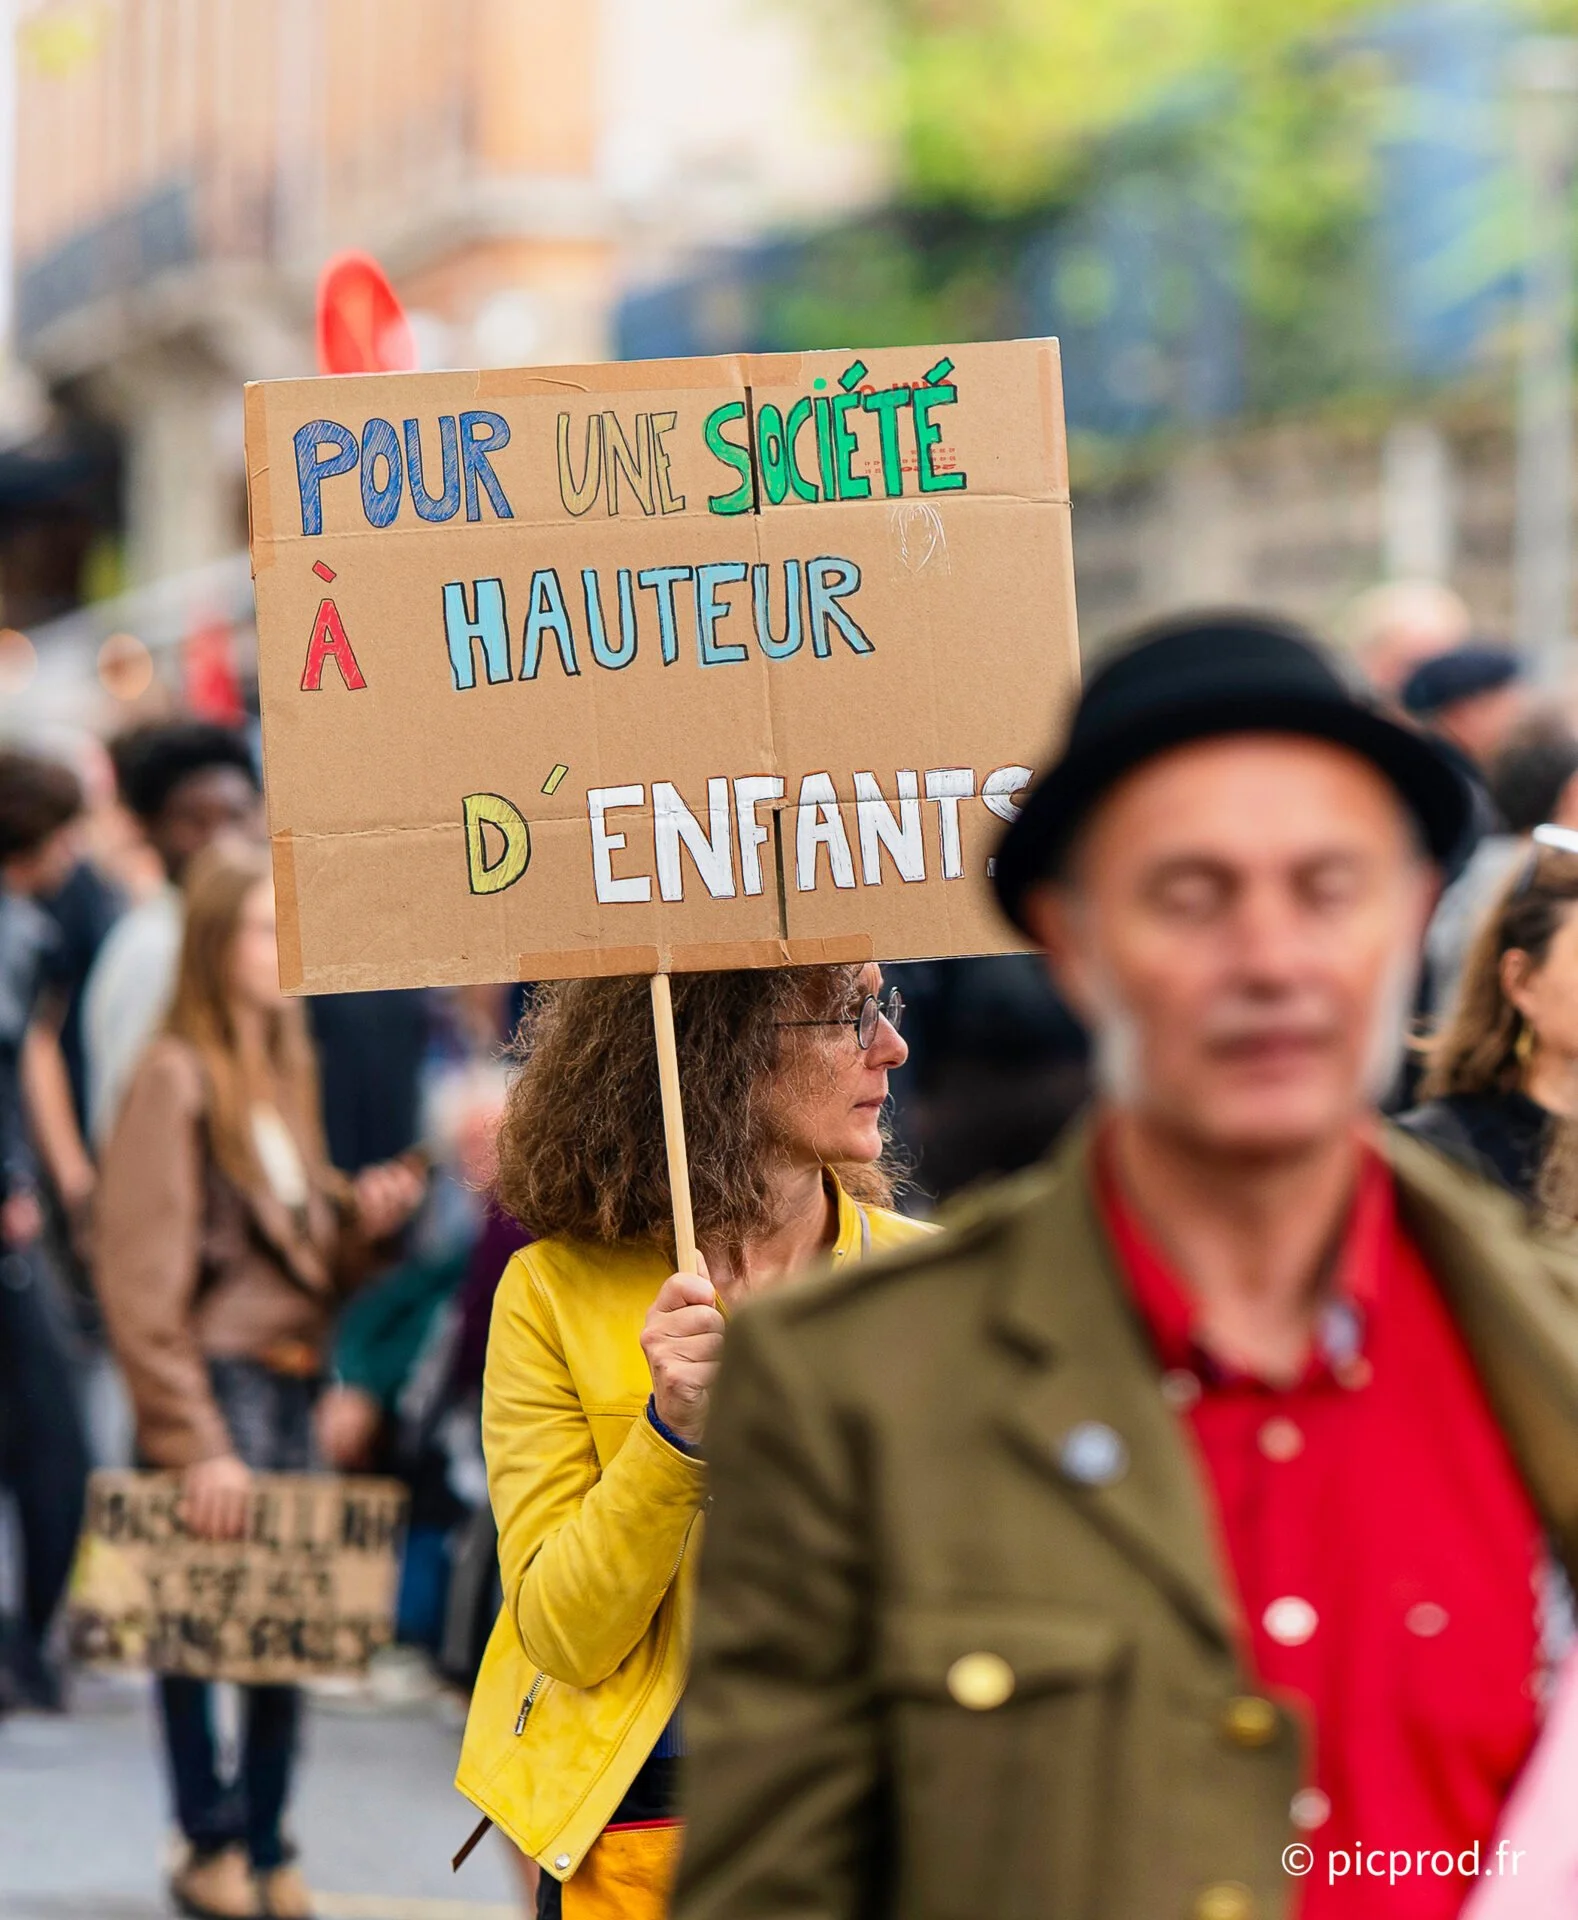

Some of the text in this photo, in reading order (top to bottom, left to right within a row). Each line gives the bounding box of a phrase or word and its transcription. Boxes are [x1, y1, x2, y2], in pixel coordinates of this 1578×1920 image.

[293, 357, 967, 536] POUR UNE SOCIÉTÉ
[301, 555, 876, 691] À HAUTEUR
